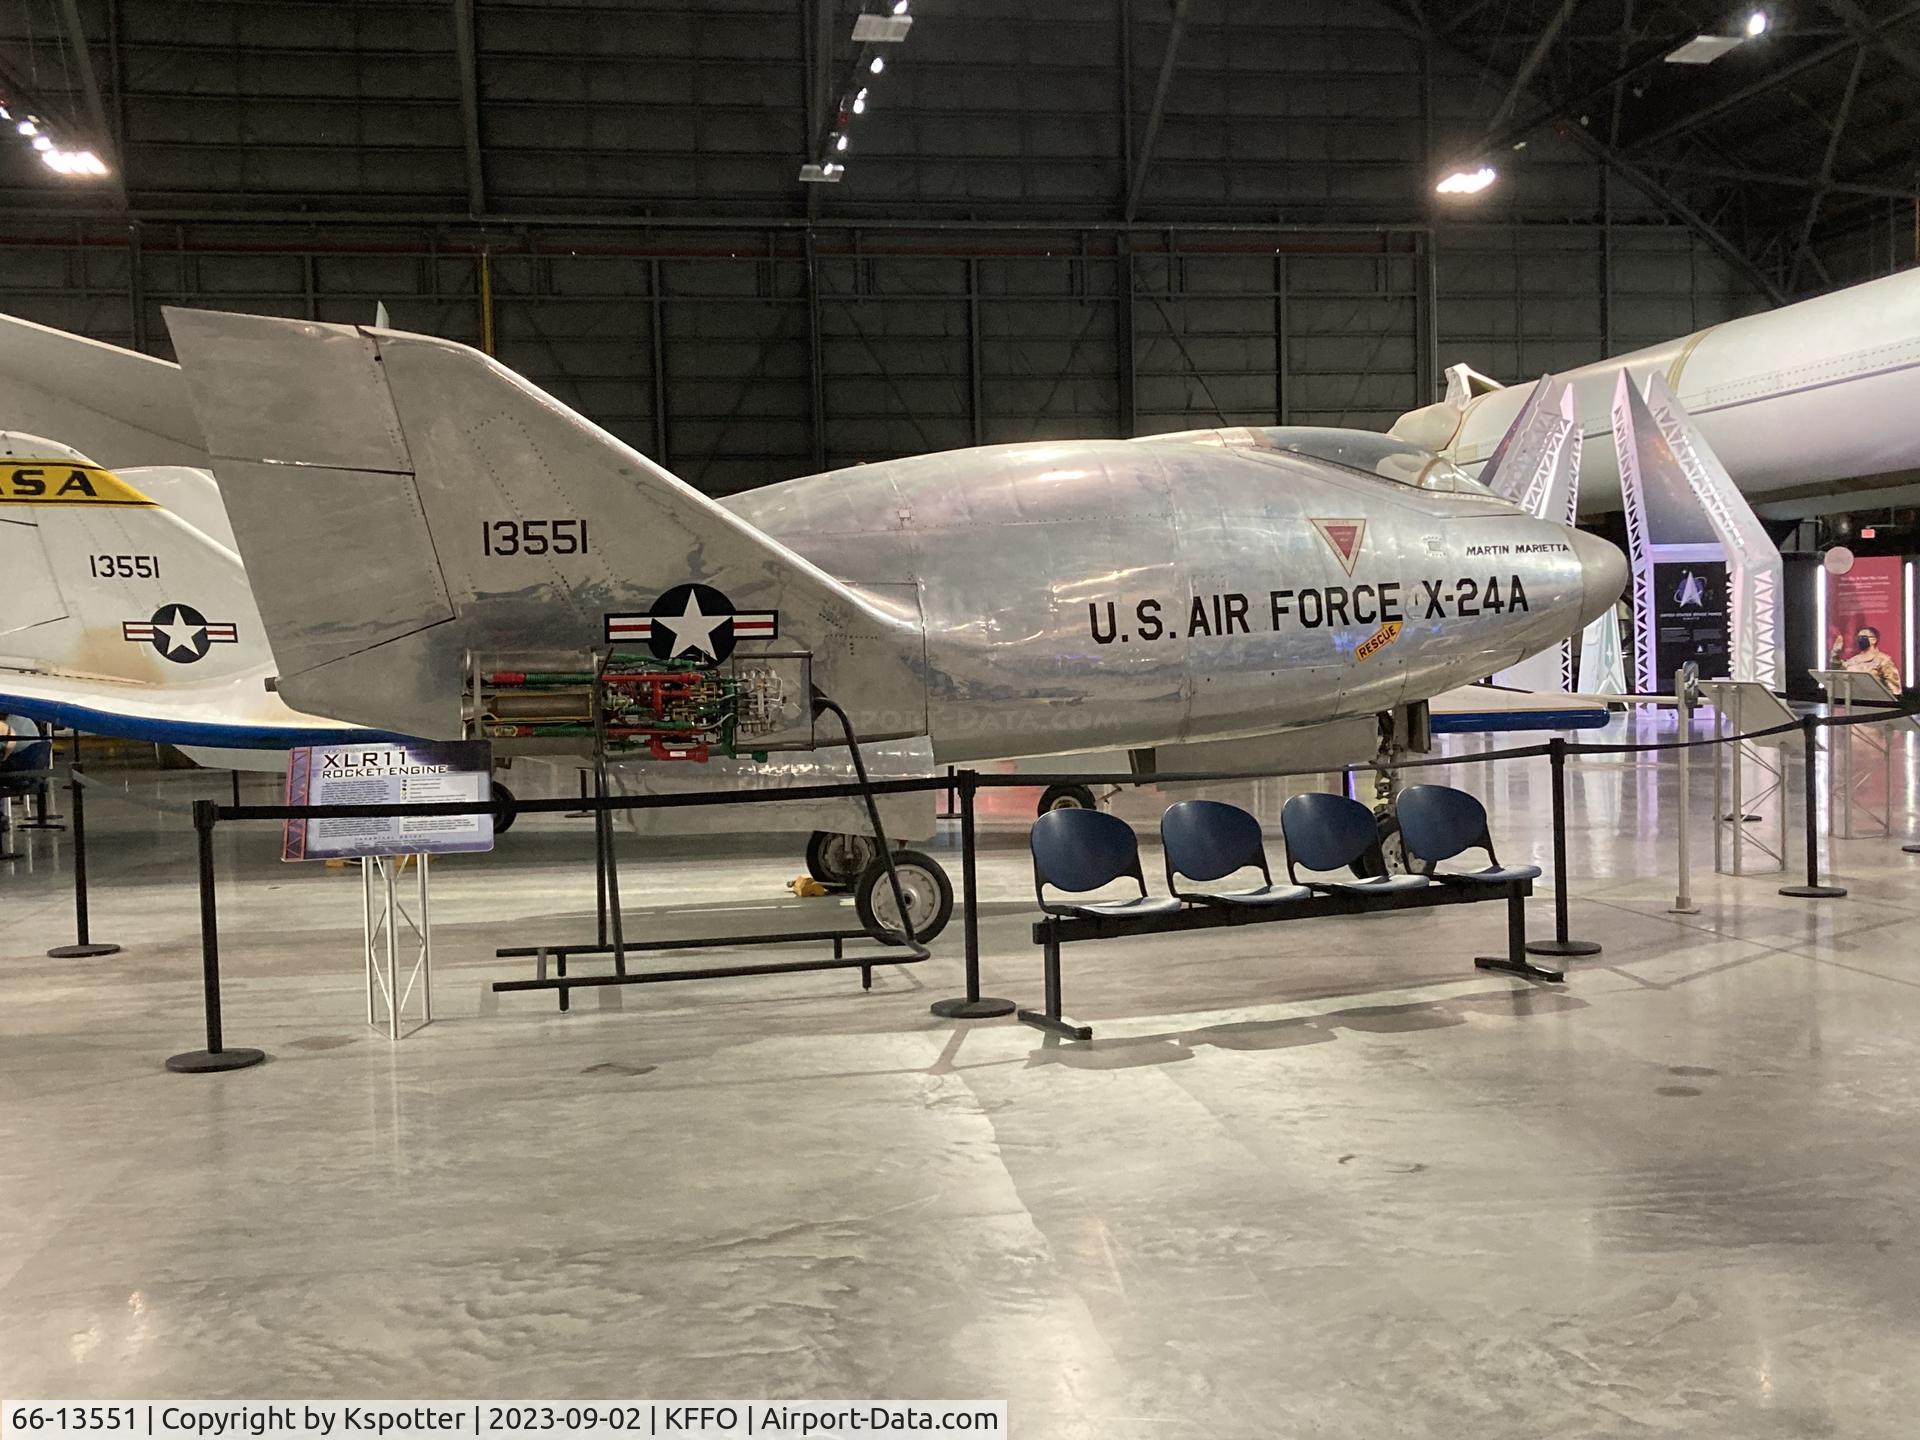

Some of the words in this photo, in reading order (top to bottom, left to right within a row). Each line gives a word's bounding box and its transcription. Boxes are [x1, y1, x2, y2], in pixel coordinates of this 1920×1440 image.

[0, 470, 98, 496] SA
[483, 520, 588, 556] 13551
[1466, 545, 1509, 556] MARTIN
[1515, 543, 1570, 553] MARIETTA
[90, 554, 160, 579] 13551
[1089, 599, 1177, 644] U.S.
[1187, 593, 1251, 637] AIR
[1270, 582, 1404, 631] FORCE
[1422, 574, 1529, 619] X-24A
[1358, 625, 1397, 658] RESCUE
[322, 768, 384, 779] ROCKET
[389, 765, 448, 776] ENGINE
[323, 751, 406, 769] XLR11
